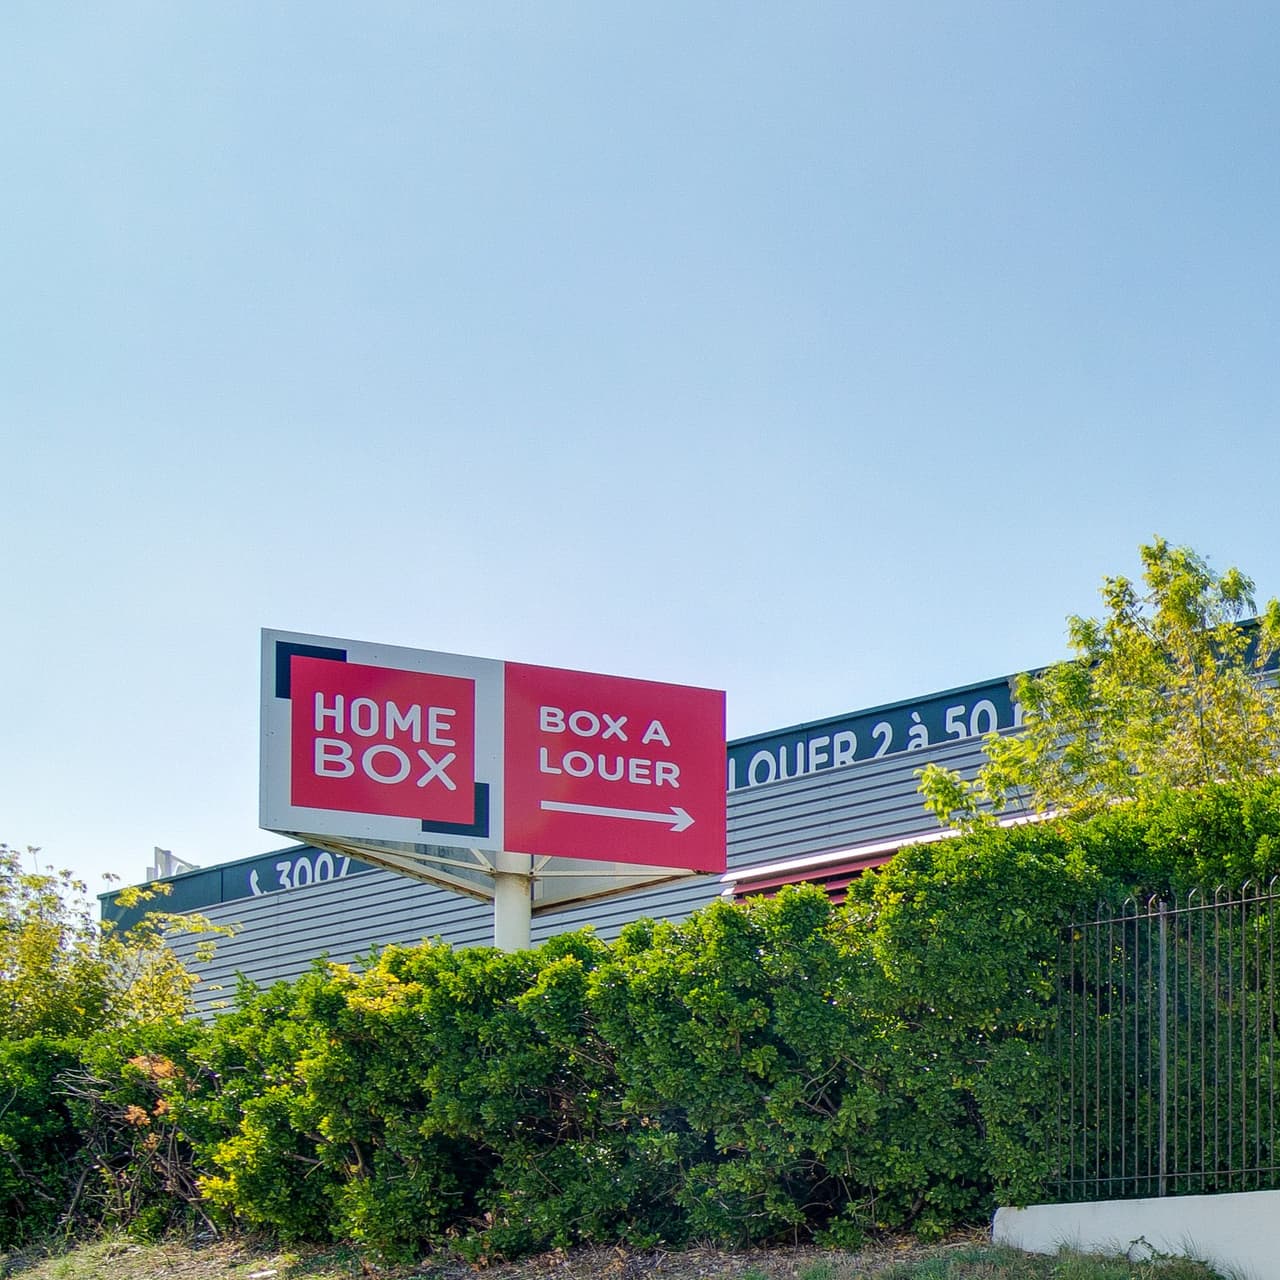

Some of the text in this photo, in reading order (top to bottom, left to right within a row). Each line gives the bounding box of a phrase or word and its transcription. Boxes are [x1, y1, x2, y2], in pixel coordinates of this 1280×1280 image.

[314, 691, 457, 747] HOME
[539, 706, 671, 747] BOX A
[728, 730, 857, 792] LOUER
[872, 721, 894, 759] 2
[907, 711, 929, 751] à
[945, 699, 998, 740] 50
[314, 737, 457, 791] BOX
[539, 746, 681, 788] LOUER
